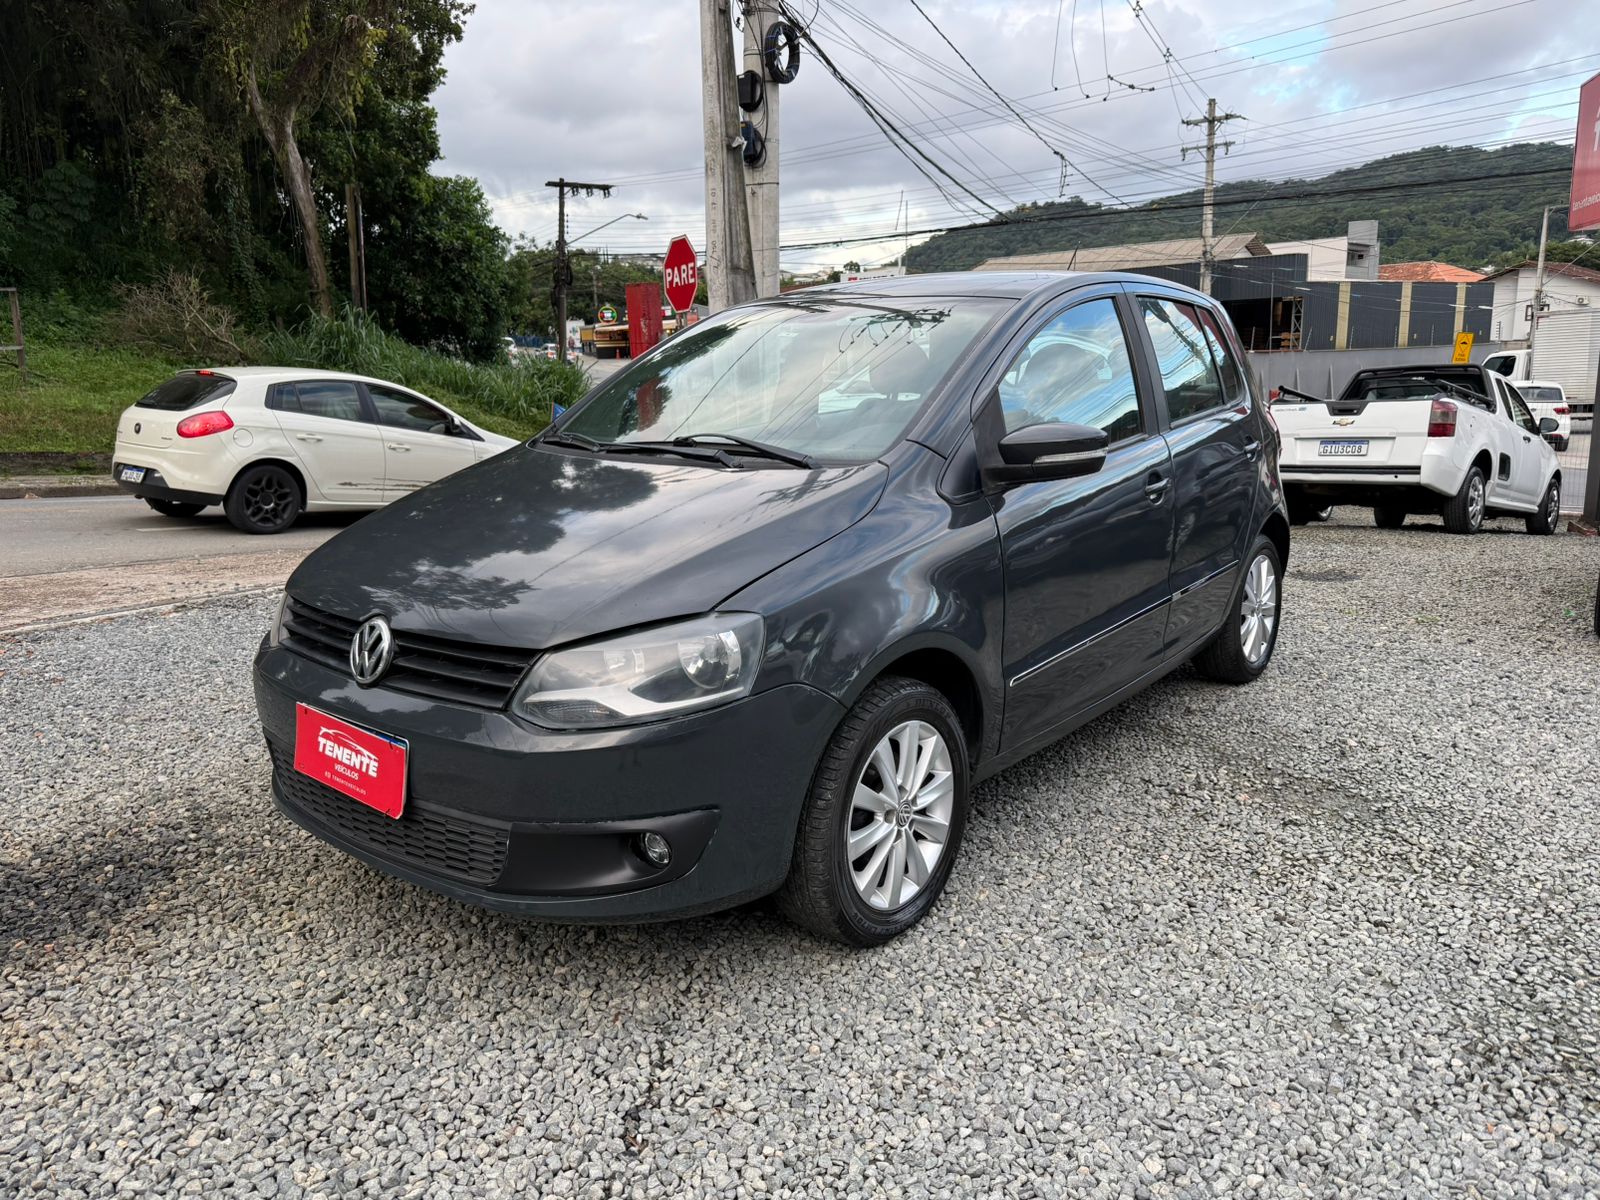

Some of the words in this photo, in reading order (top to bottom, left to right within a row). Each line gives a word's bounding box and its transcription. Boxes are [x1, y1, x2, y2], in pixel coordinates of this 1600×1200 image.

[665, 262, 695, 289] PARE
[1322, 445, 1363, 454] GIU3C08
[318, 736, 379, 778] TENENTE
